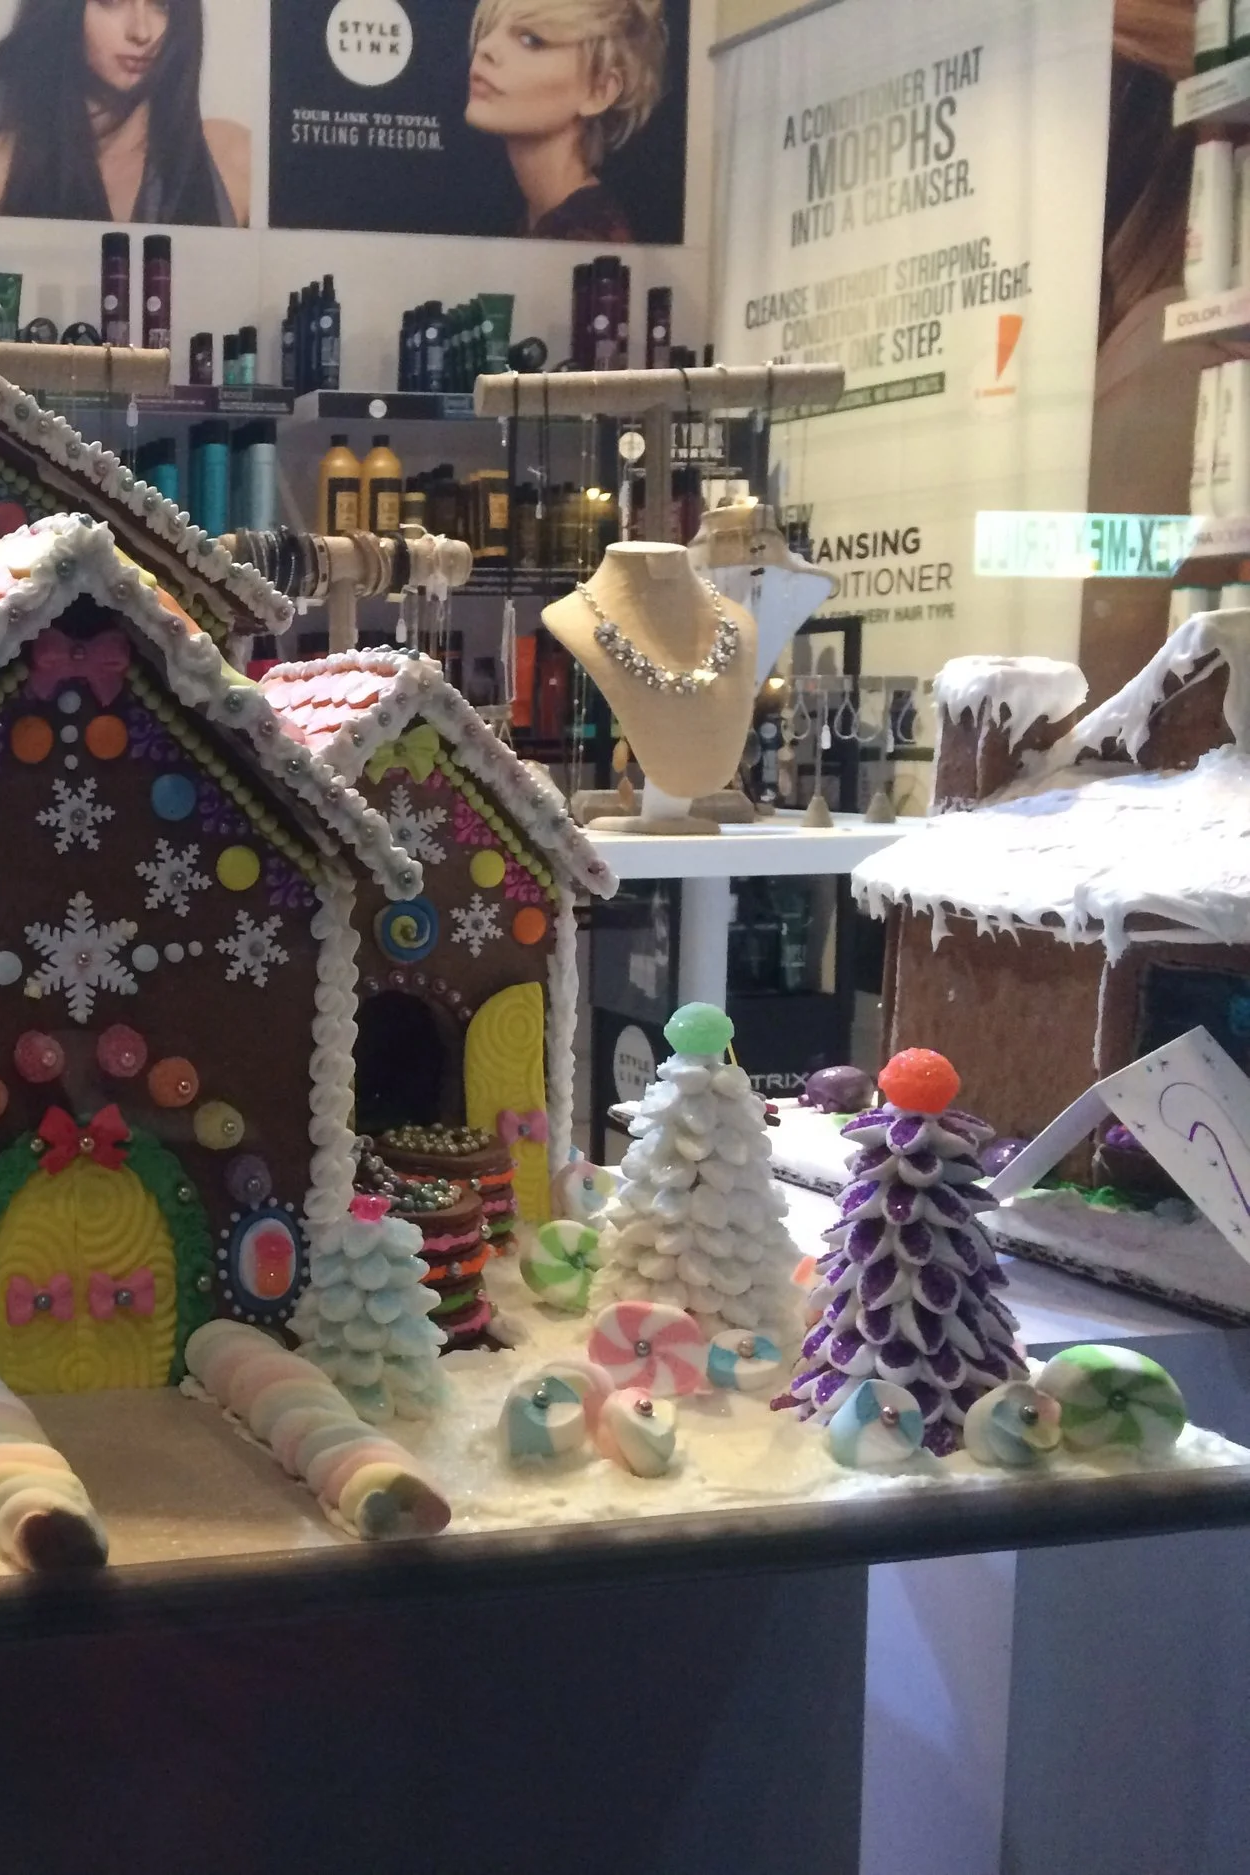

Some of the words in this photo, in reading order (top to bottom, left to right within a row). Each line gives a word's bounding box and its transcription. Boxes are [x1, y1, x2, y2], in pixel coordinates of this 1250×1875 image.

[338, 20, 401, 37] STYLE
[338, 38, 401, 55] LINK
[783, 115, 796, 150] A
[801, 67, 927, 144] CONDITIONER
[932, 45, 984, 97] THAT
[291, 123, 359, 147] STYLING
[368, 127, 445, 150] FREEDOM.
[292, 108, 330, 122] YOUR
[334, 110, 369, 125] LINK
[372, 112, 393, 126] TO
[395, 114, 440, 128] TOTAL
[807, 95, 957, 203] MORPHS
[791, 201, 835, 248] INTO
[842, 194, 855, 233] A
[863, 158, 975, 226] CLEANSER.
[745, 285, 810, 330] CLEANSE
[814, 262, 891, 311] WITHOUT
[895, 236, 998, 291] STRIPPING.
[782, 304, 868, 351] CONDITION
[875, 282, 957, 335] WITHOUT
[961, 260, 1033, 310] WEIGHT.
[850, 333, 886, 372] ONE
[891, 320, 944, 365] STEP.
[809, 526, 922, 564] ANSING
[926, 601, 956, 621] TYPE
[750, 1072, 810, 1090] TRIX
